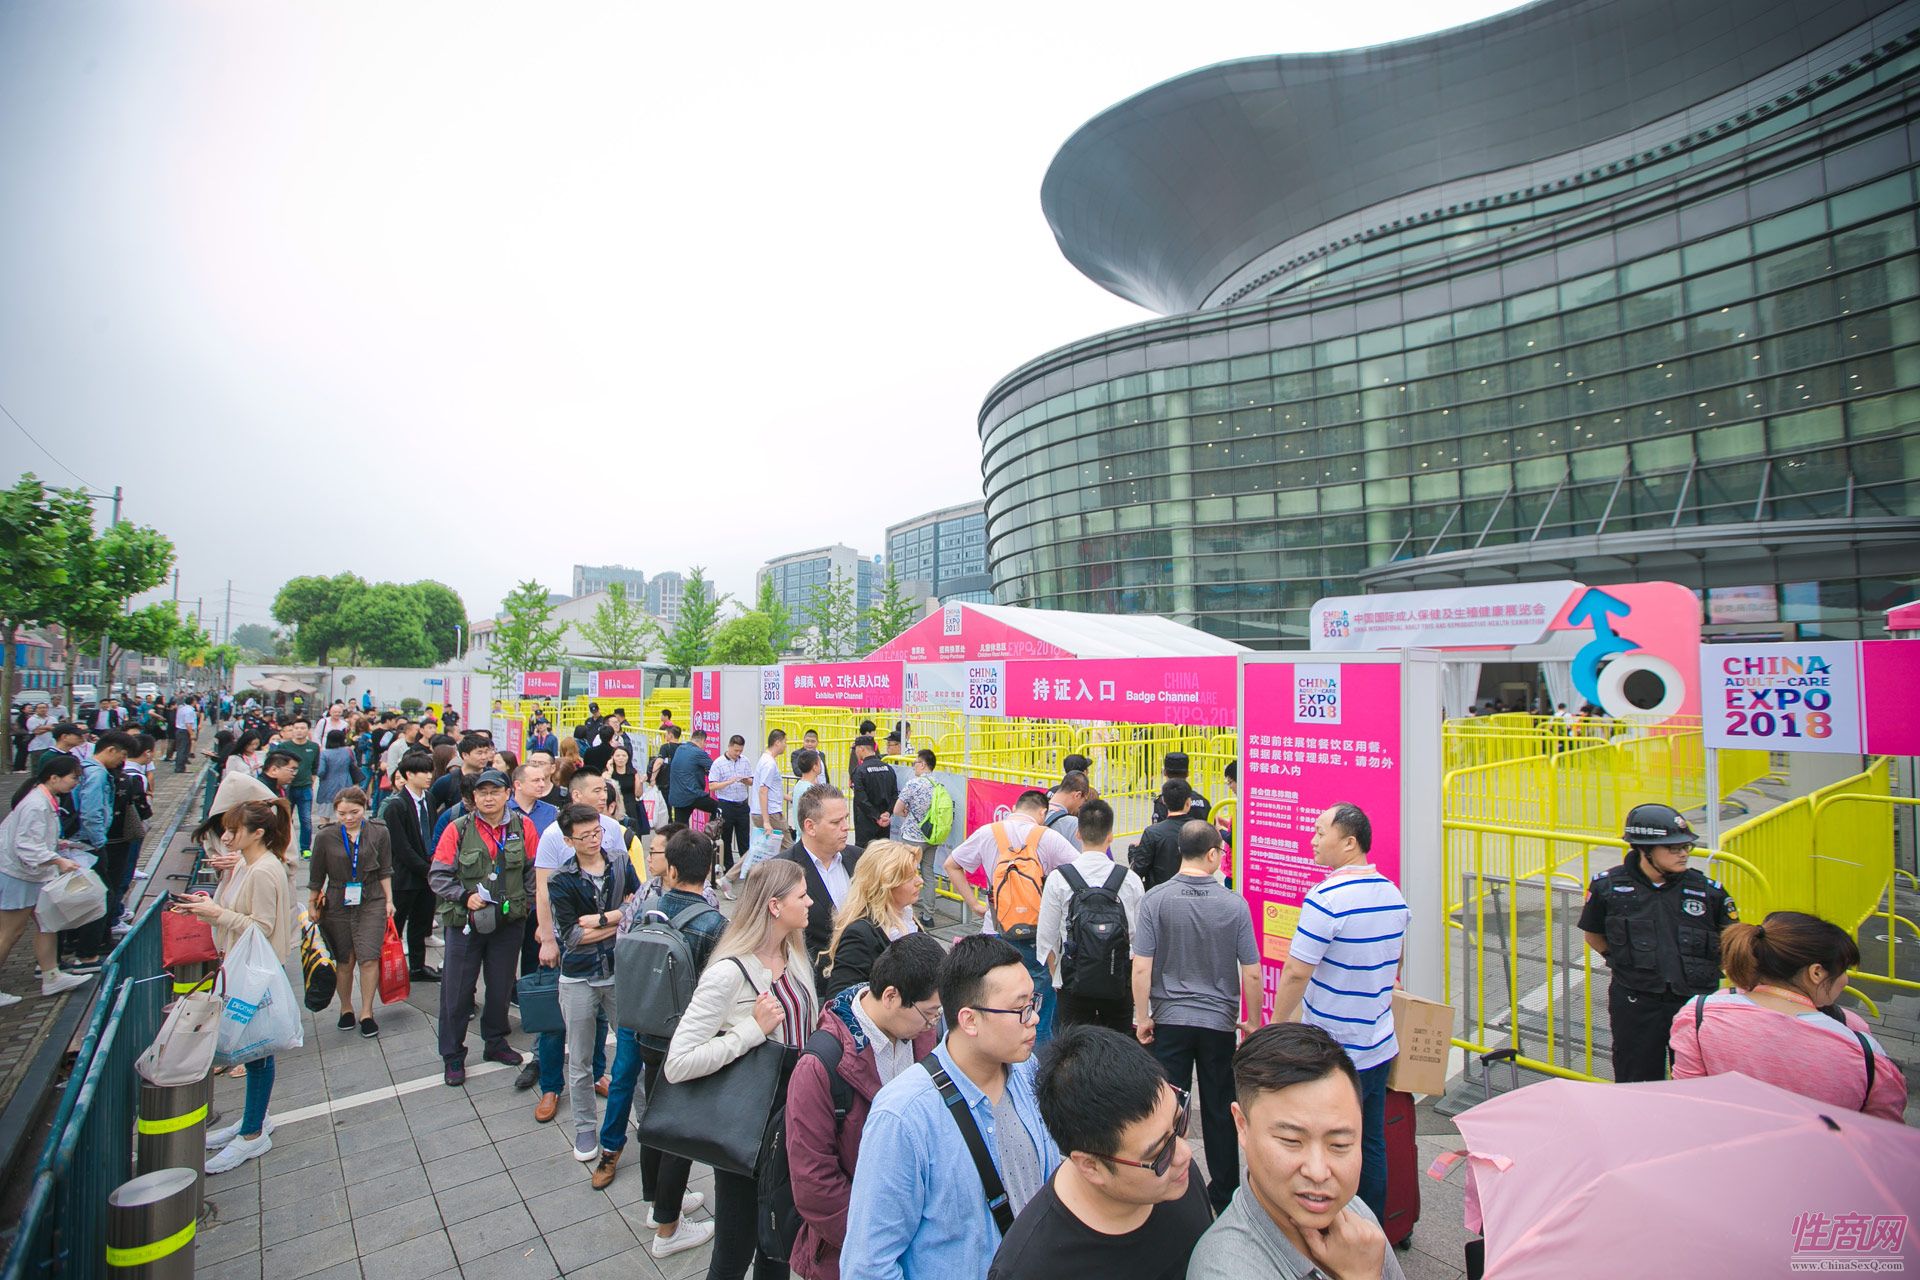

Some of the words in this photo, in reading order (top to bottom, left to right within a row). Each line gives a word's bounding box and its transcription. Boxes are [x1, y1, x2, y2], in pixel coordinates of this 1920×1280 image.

[1324, 628, 1349, 637] 2018
[1722, 656, 1833, 676] CHINA
[970, 668, 998, 678] CHINA
[764, 682, 780, 690] EXPO
[1298, 678, 1336, 688] CHINA
[1724, 677, 1830, 687] ADULT-CARE
[764, 691, 780, 700] 2018
[970, 684, 998, 696] EXPO
[1033, 678, 1116, 701] 持证入口
[970, 696, 998, 709] 2018
[1126, 690, 1156, 704] Badge
[1158, 690, 1200, 703] Channel
[1299, 694, 1336, 705] EXPO
[1725, 688, 1832, 711] EXPO
[1211, 708, 1236, 727] 201
[1299, 705, 1336, 718] 2018
[1725, 711, 1833, 739] 2018
[1249, 762, 1302, 776] 带餐食入内
